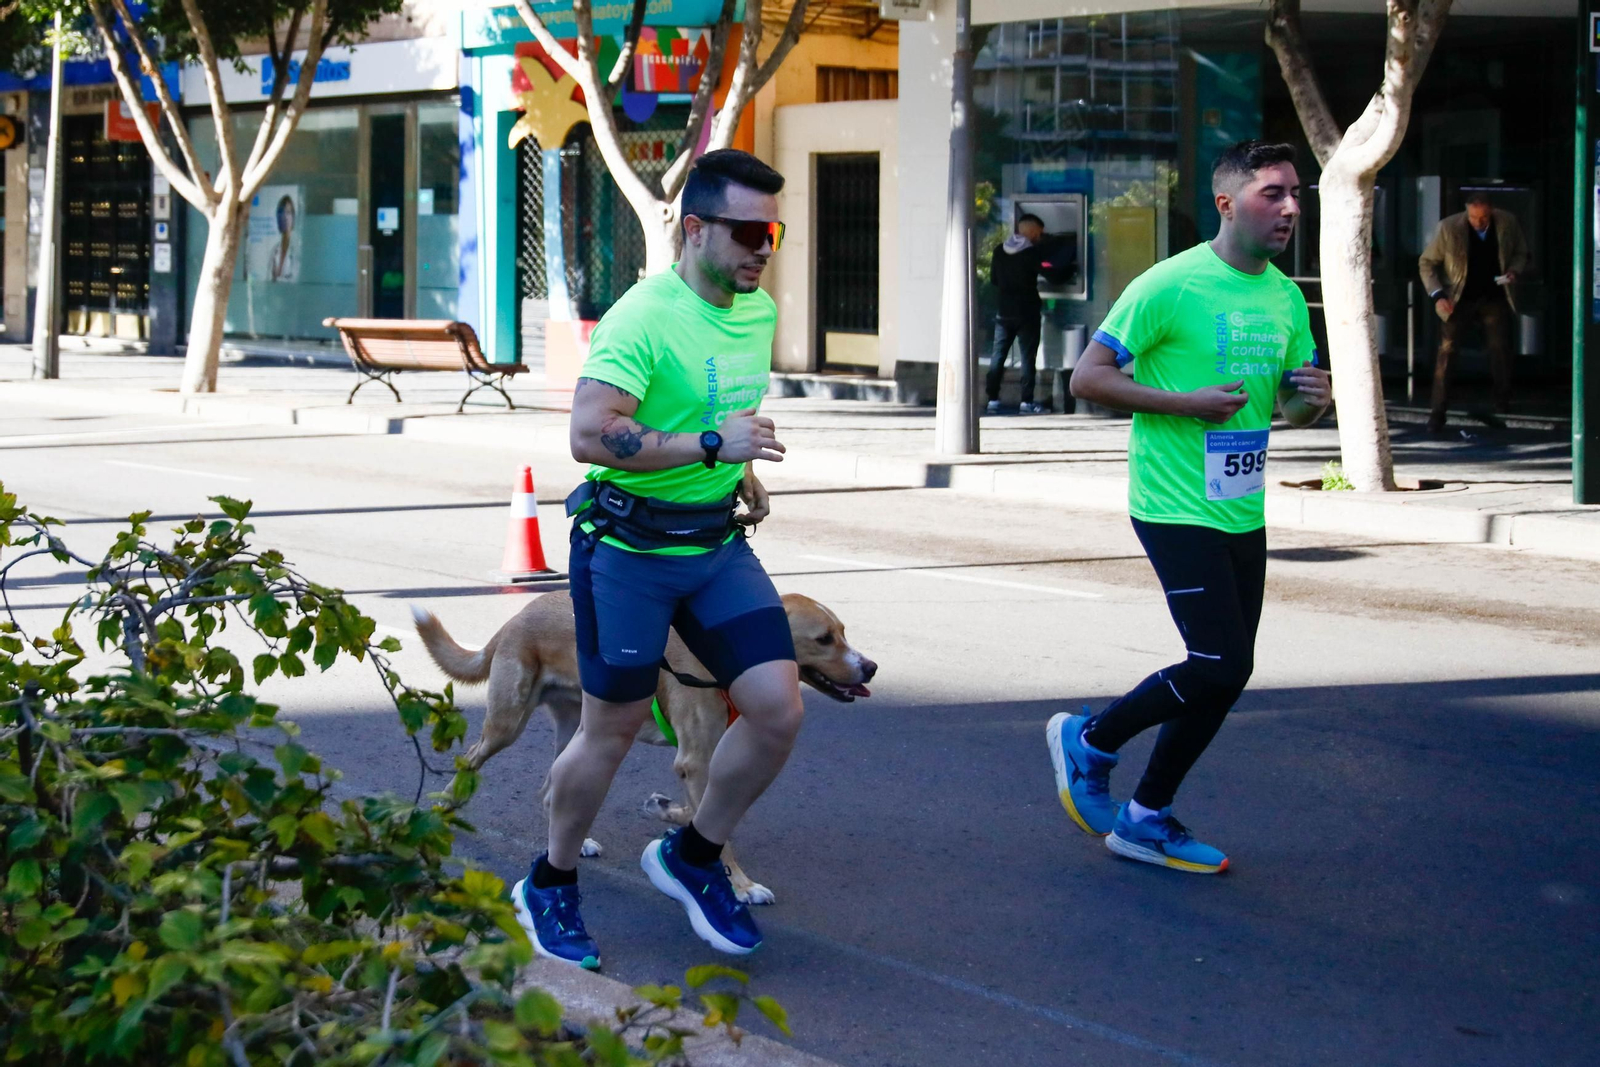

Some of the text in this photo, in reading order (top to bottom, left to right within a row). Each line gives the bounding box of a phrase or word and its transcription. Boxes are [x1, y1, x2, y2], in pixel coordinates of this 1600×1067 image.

[1212, 311, 1228, 376] ALMERÍA
[1231, 329, 1248, 342] En
[1231, 344, 1274, 357] contra
[720, 375, 733, 389] En
[700, 356, 718, 425] ALMERÍA
[719, 388, 757, 404] contra
[1223, 450, 1267, 477] 599
